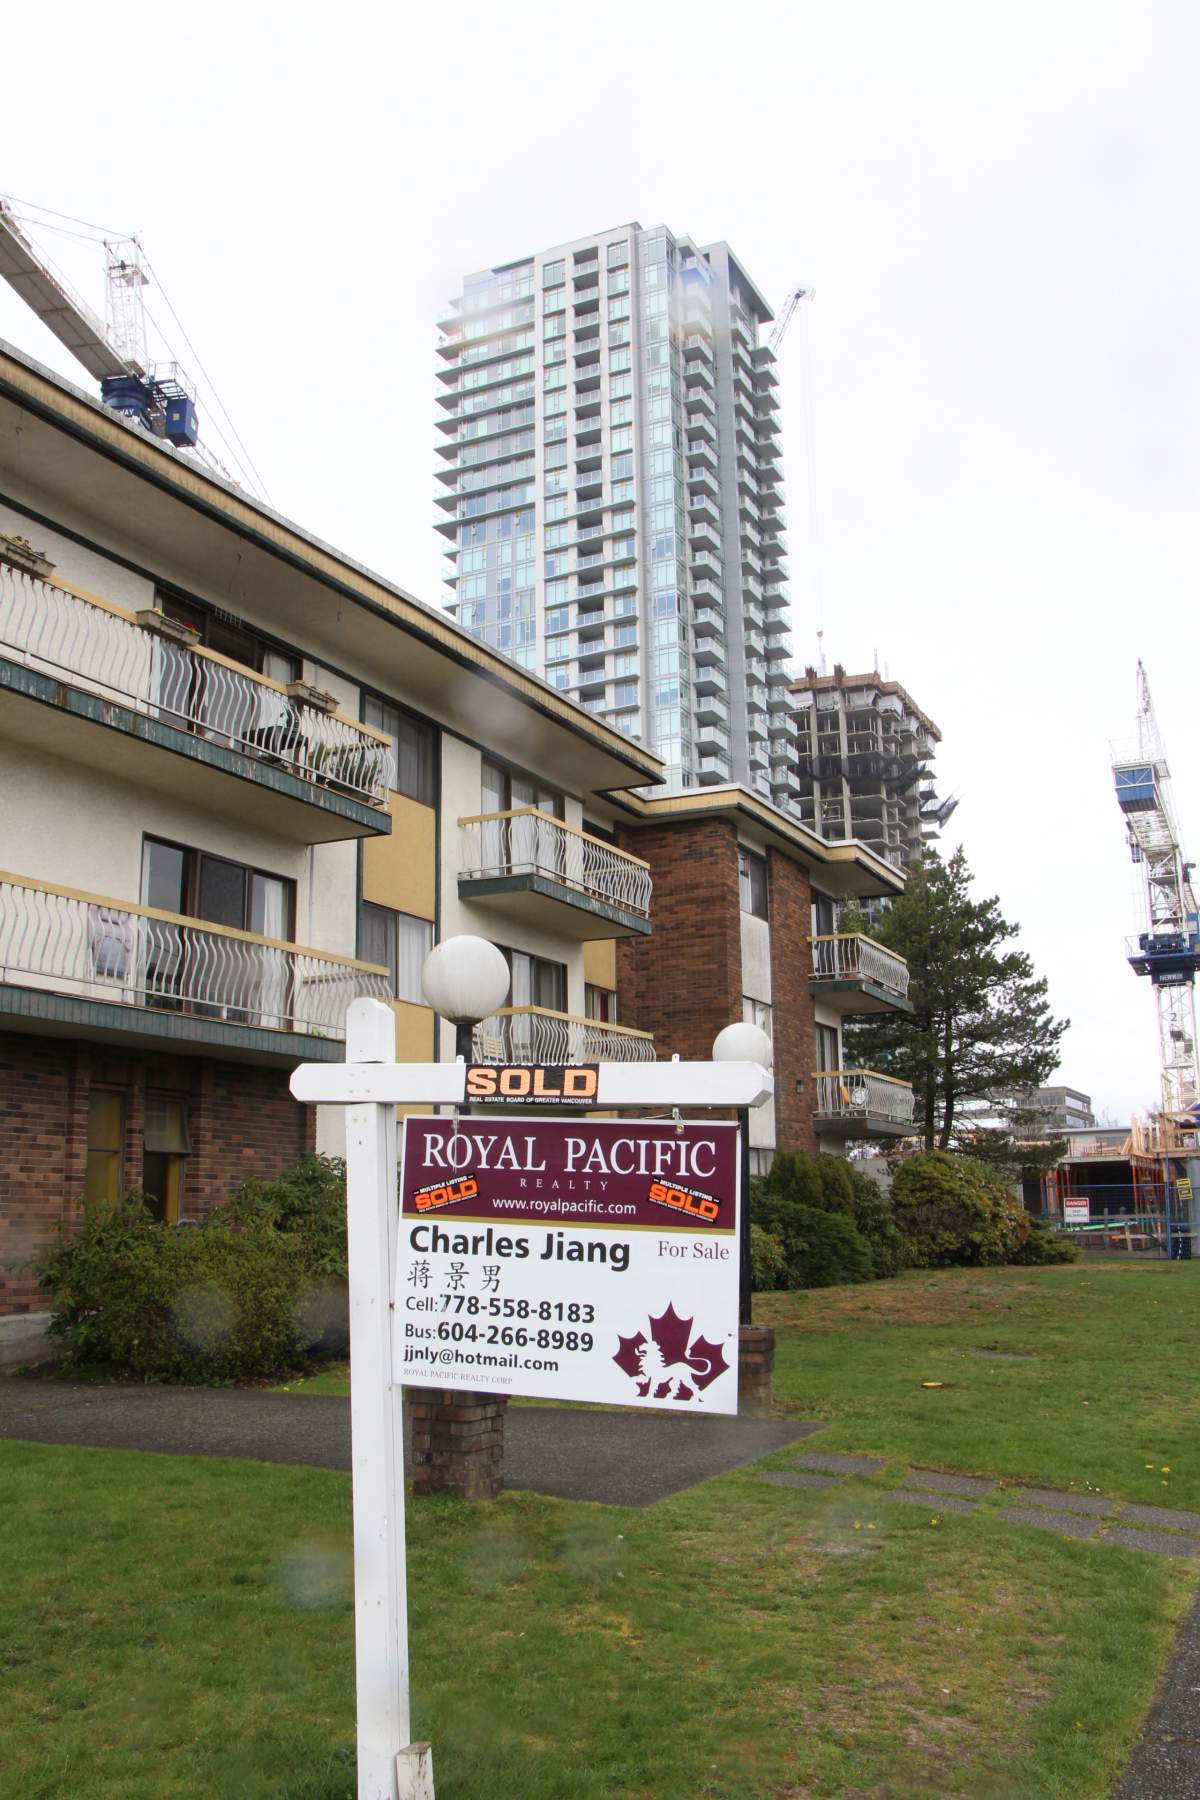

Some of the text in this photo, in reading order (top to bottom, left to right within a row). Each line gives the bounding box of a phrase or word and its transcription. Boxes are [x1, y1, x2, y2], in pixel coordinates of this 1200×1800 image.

[467, 1069, 596, 1096] SOLD
[506, 1096, 525, 1104] BOARD
[421, 1133, 716, 1178] ROYAL PACIFIC
[415, 1179, 478, 1210] SOLD
[420, 1176, 467, 1193] MULTIPLE LISTING
[519, 1178, 608, 1191] REALTY
[660, 1180, 712, 1201] MULTIPLE LISTING
[492, 1198, 637, 1215] www.royalpacific.com
[649, 1183, 719, 1219] SOLD
[409, 1225, 630, 1272] Charles Jiang
[657, 1240, 730, 1260] For Sale
[403, 1345, 559, 1372] jjnly@hotmail.com
[403, 1367, 513, 1385] ROYAL PACIFIC REALTY CORP
